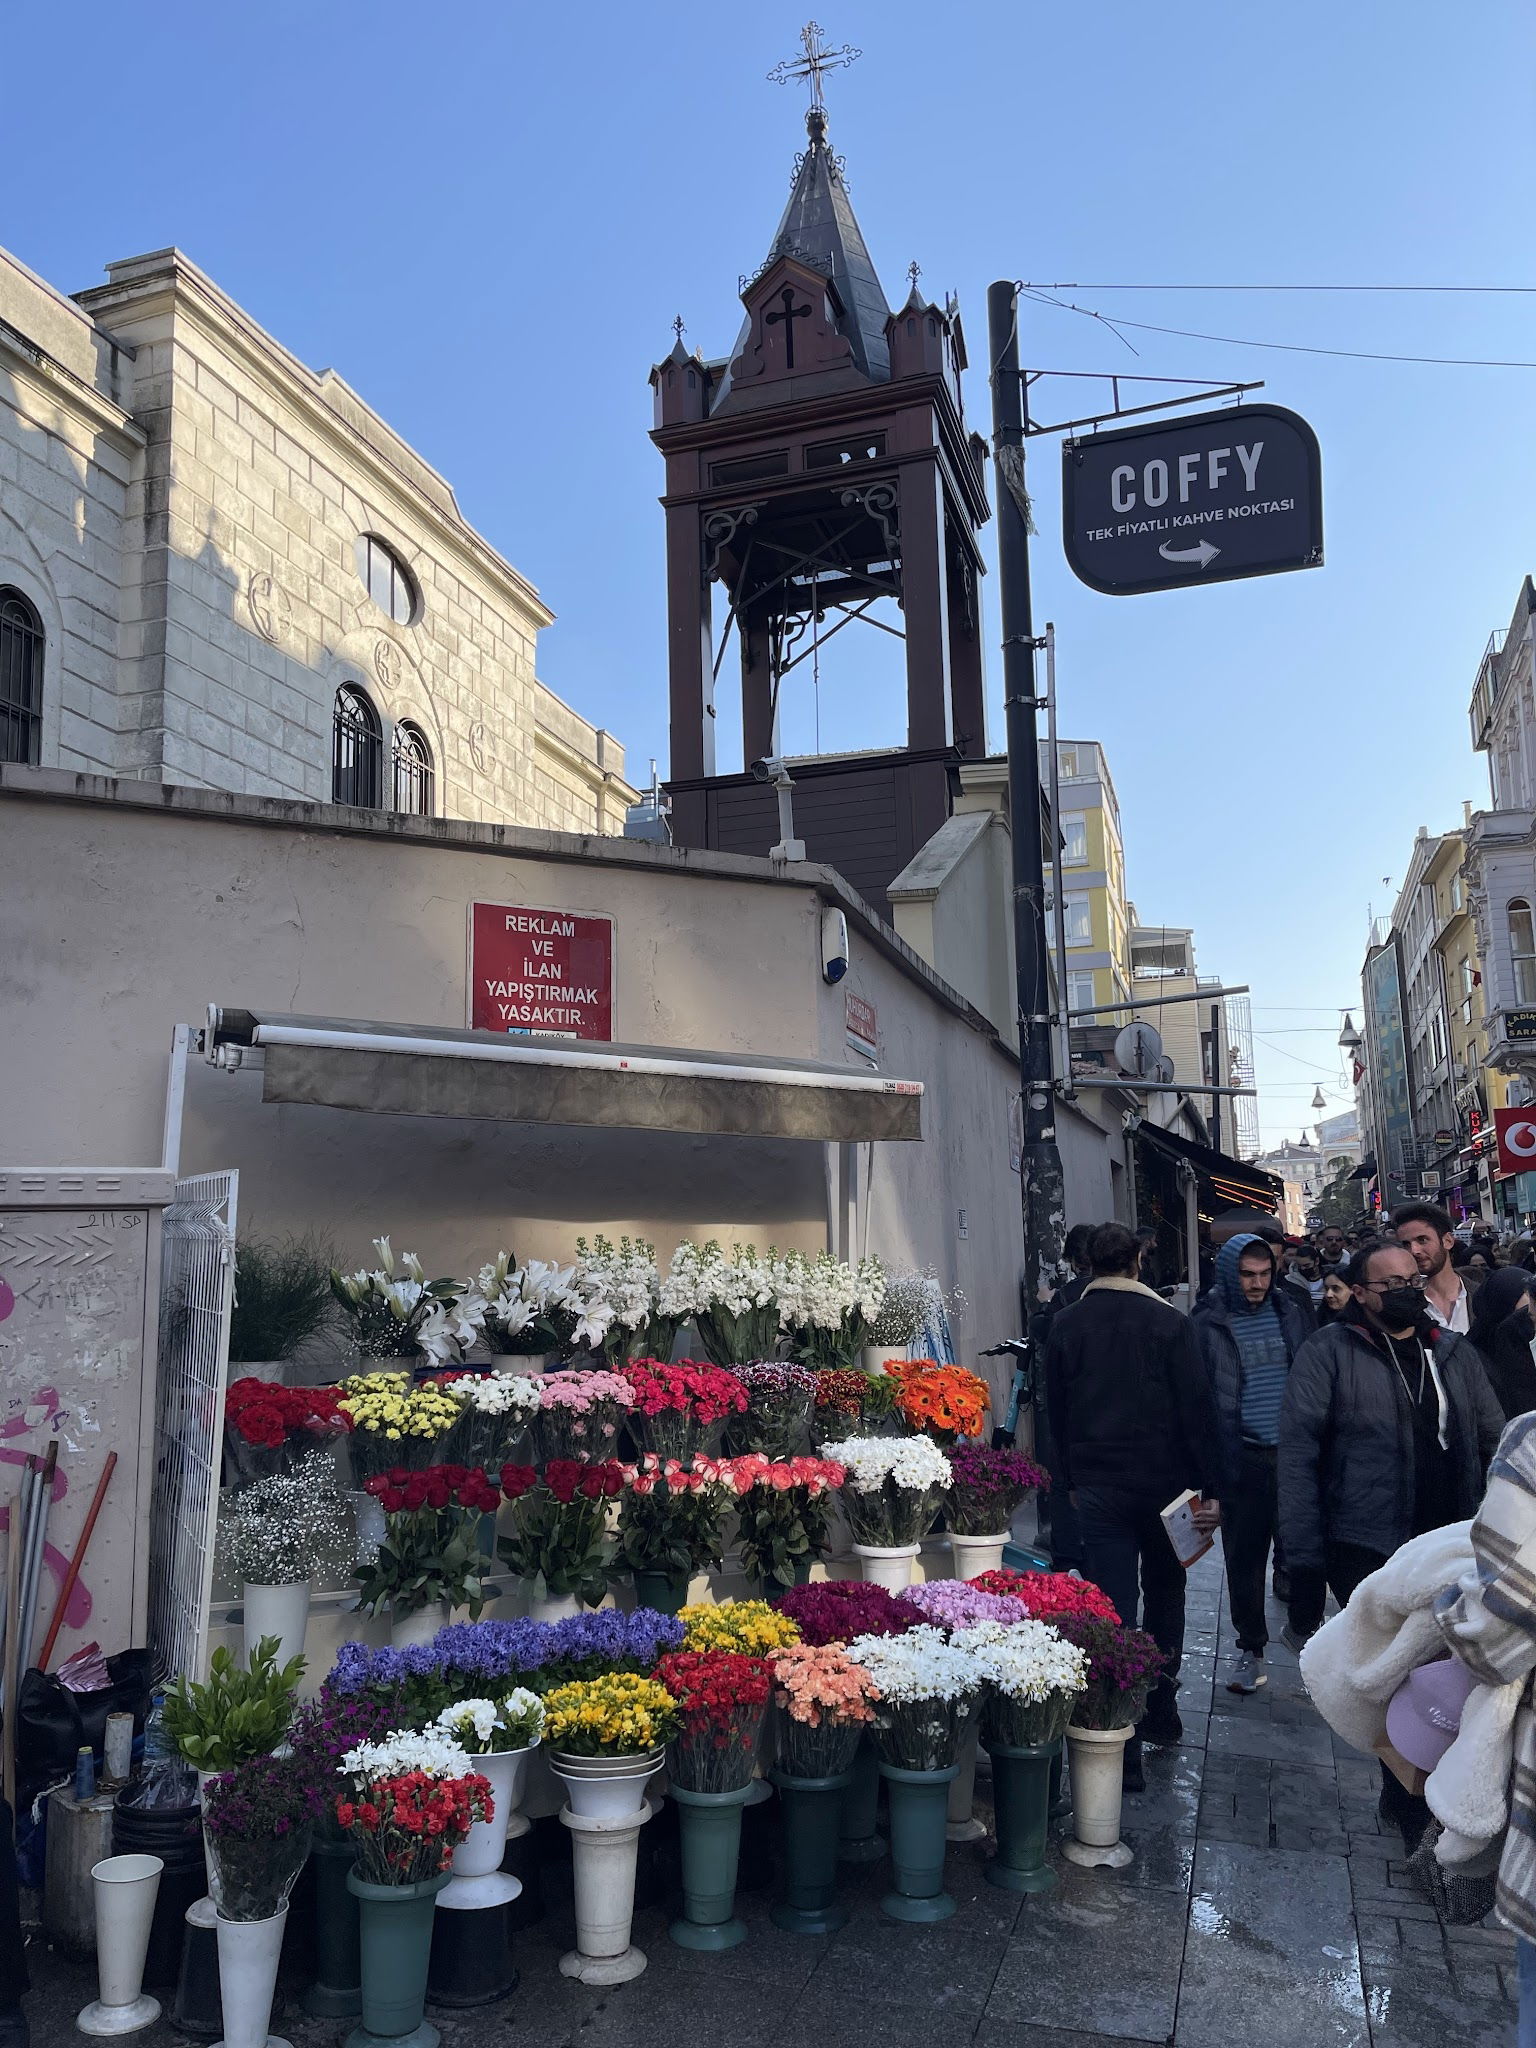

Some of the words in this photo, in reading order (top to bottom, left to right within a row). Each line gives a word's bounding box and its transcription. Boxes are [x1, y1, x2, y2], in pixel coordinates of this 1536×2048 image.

[1111, 441, 1264, 513] COFFY
[1087, 527, 1114, 542] TEK
[1117, 518, 1169, 537] FİYATLI
[1173, 508, 1224, 527] KAHVE
[1228, 498, 1295, 519] NOKTASI
[505, 914, 575, 937] REKLAM
[531, 940, 554, 957] VE
[523, 957, 562, 979] İLAN
[485, 980, 599, 1005] YAPIŞTIRMAK
[497, 1003, 586, 1025] YASAKTIR.
